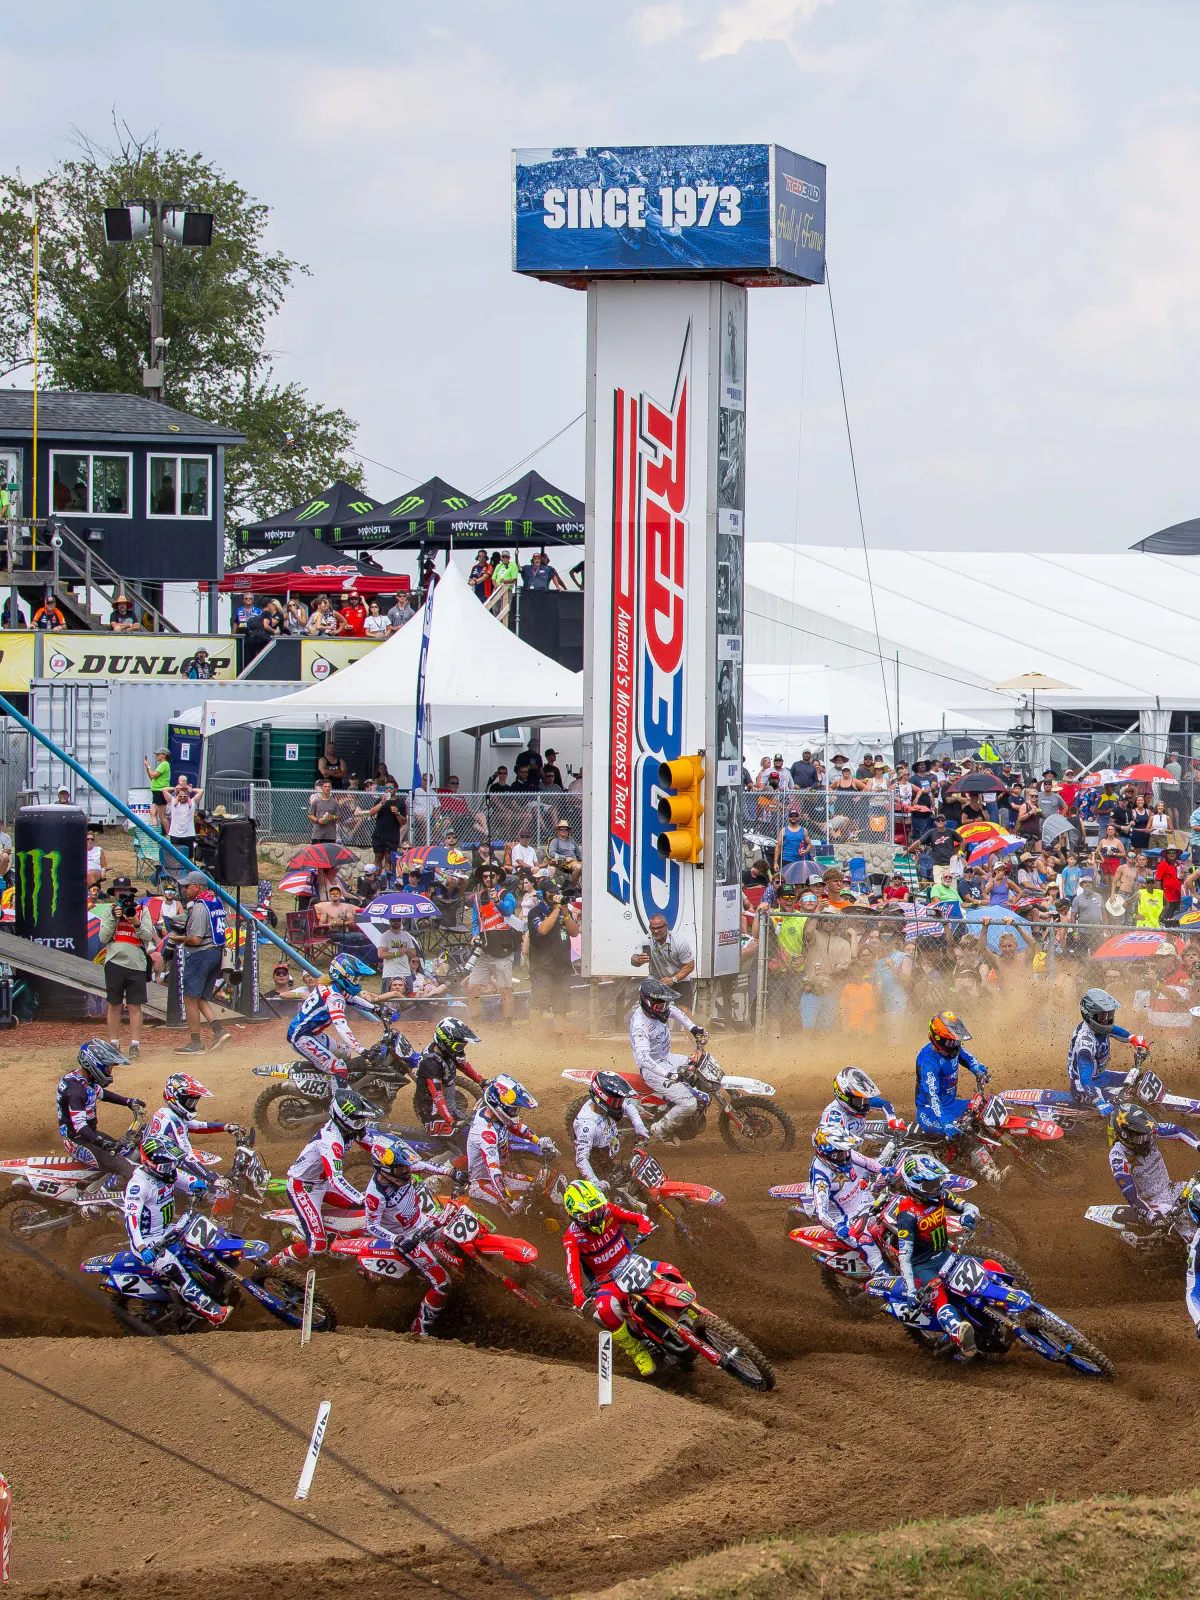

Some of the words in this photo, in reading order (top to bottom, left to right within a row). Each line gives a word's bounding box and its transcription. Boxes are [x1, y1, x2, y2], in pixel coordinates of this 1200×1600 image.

[543, 186, 647, 229] SINCE
[659, 186, 743, 227] 1973
[777, 203, 795, 240] Hall
[793, 217, 802, 258] of
[802, 213, 824, 251] Fame
[264, 529, 296, 540] MONSTER
[358, 525, 391, 535] MONSTER
[452, 521, 489, 531] MONSTER
[613, 782, 628, 829] TRACK
[392, 905, 414, 914] 100%
[301, 1079, 327, 1097] 483
[1142, 1073, 1162, 1103] 35
[987, 1098, 1007, 1126] 74
[36, 1179, 60, 1195] 55
[640, 1163, 663, 1188] 199
[193, 1219, 217, 1244] 2
[453, 1214, 478, 1241] 96
[372, 1249, 395, 1257] HONDA
[593, 1237, 626, 1265] DUCATI
[835, 1254, 857, 1273] 51
[376, 1259, 397, 1275] 96
[622, 1258, 654, 1293] 222
[954, 1259, 984, 1295] 32
[121, 1274, 143, 1294] 2
[898, 1302, 921, 1325] 32
[1019, 1333, 1048, 1355] DUNLOP
[601, 1350, 609, 1381] UFO
[311, 1426, 324, 1459] UFO
